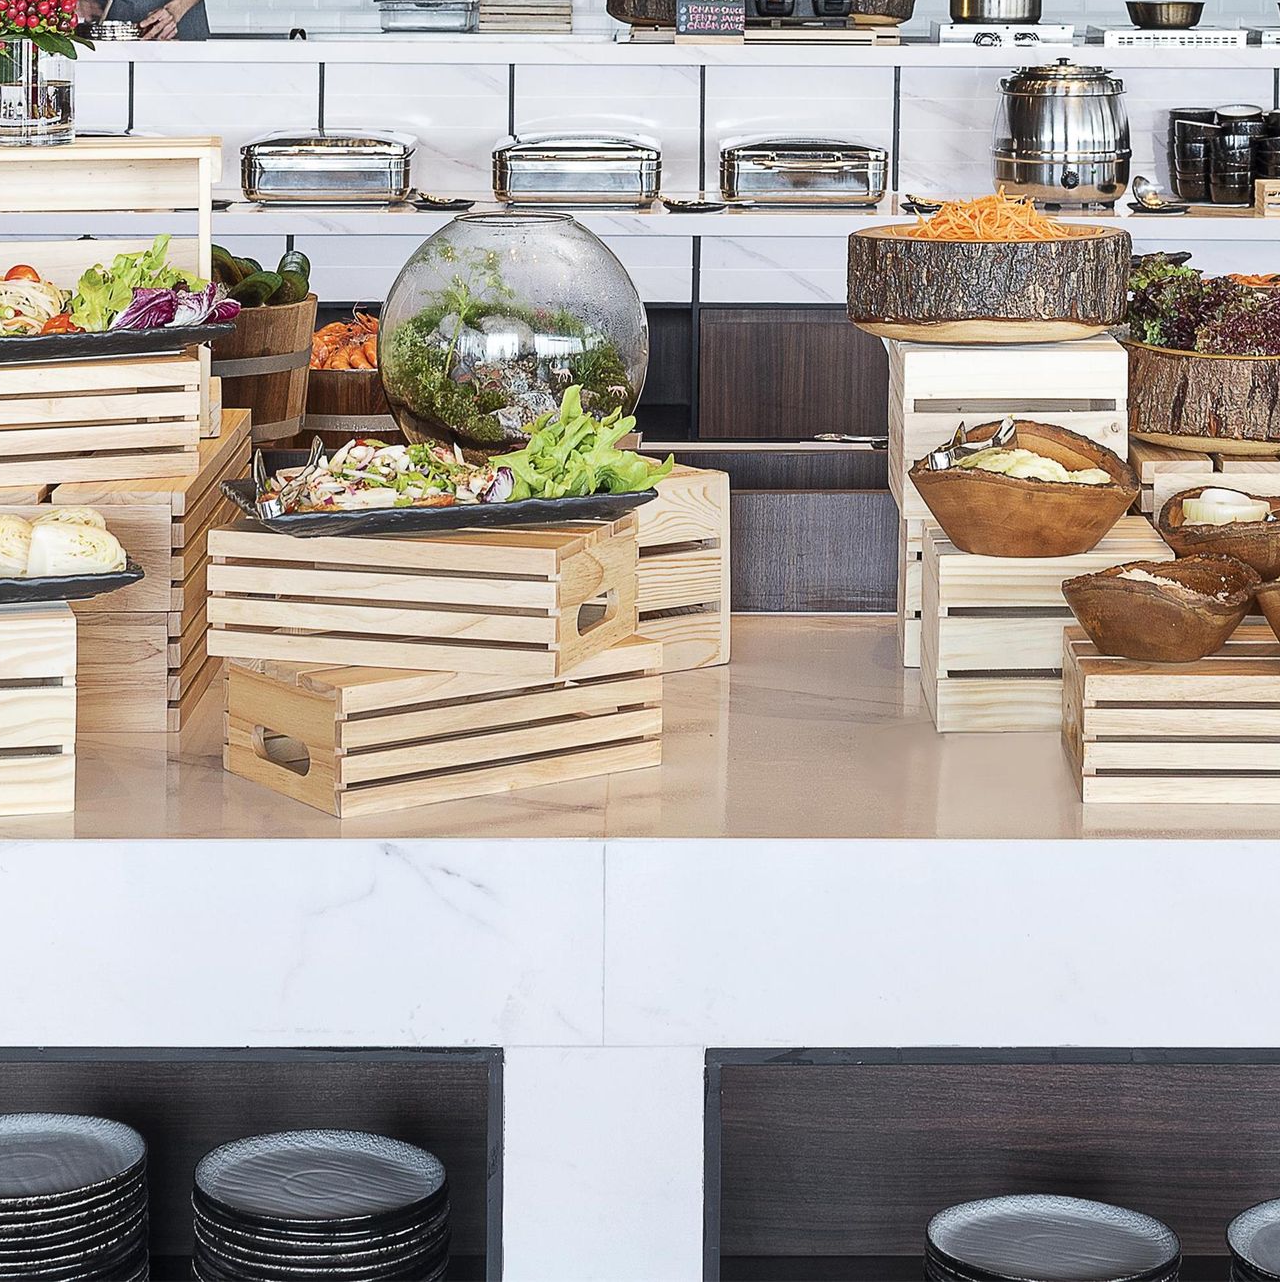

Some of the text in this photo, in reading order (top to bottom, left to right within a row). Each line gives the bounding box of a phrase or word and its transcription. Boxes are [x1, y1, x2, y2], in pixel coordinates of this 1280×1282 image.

[688, 5, 745, 14] TOMATO SAUCE
[687, 21, 745, 31] CREAM SAUCE
